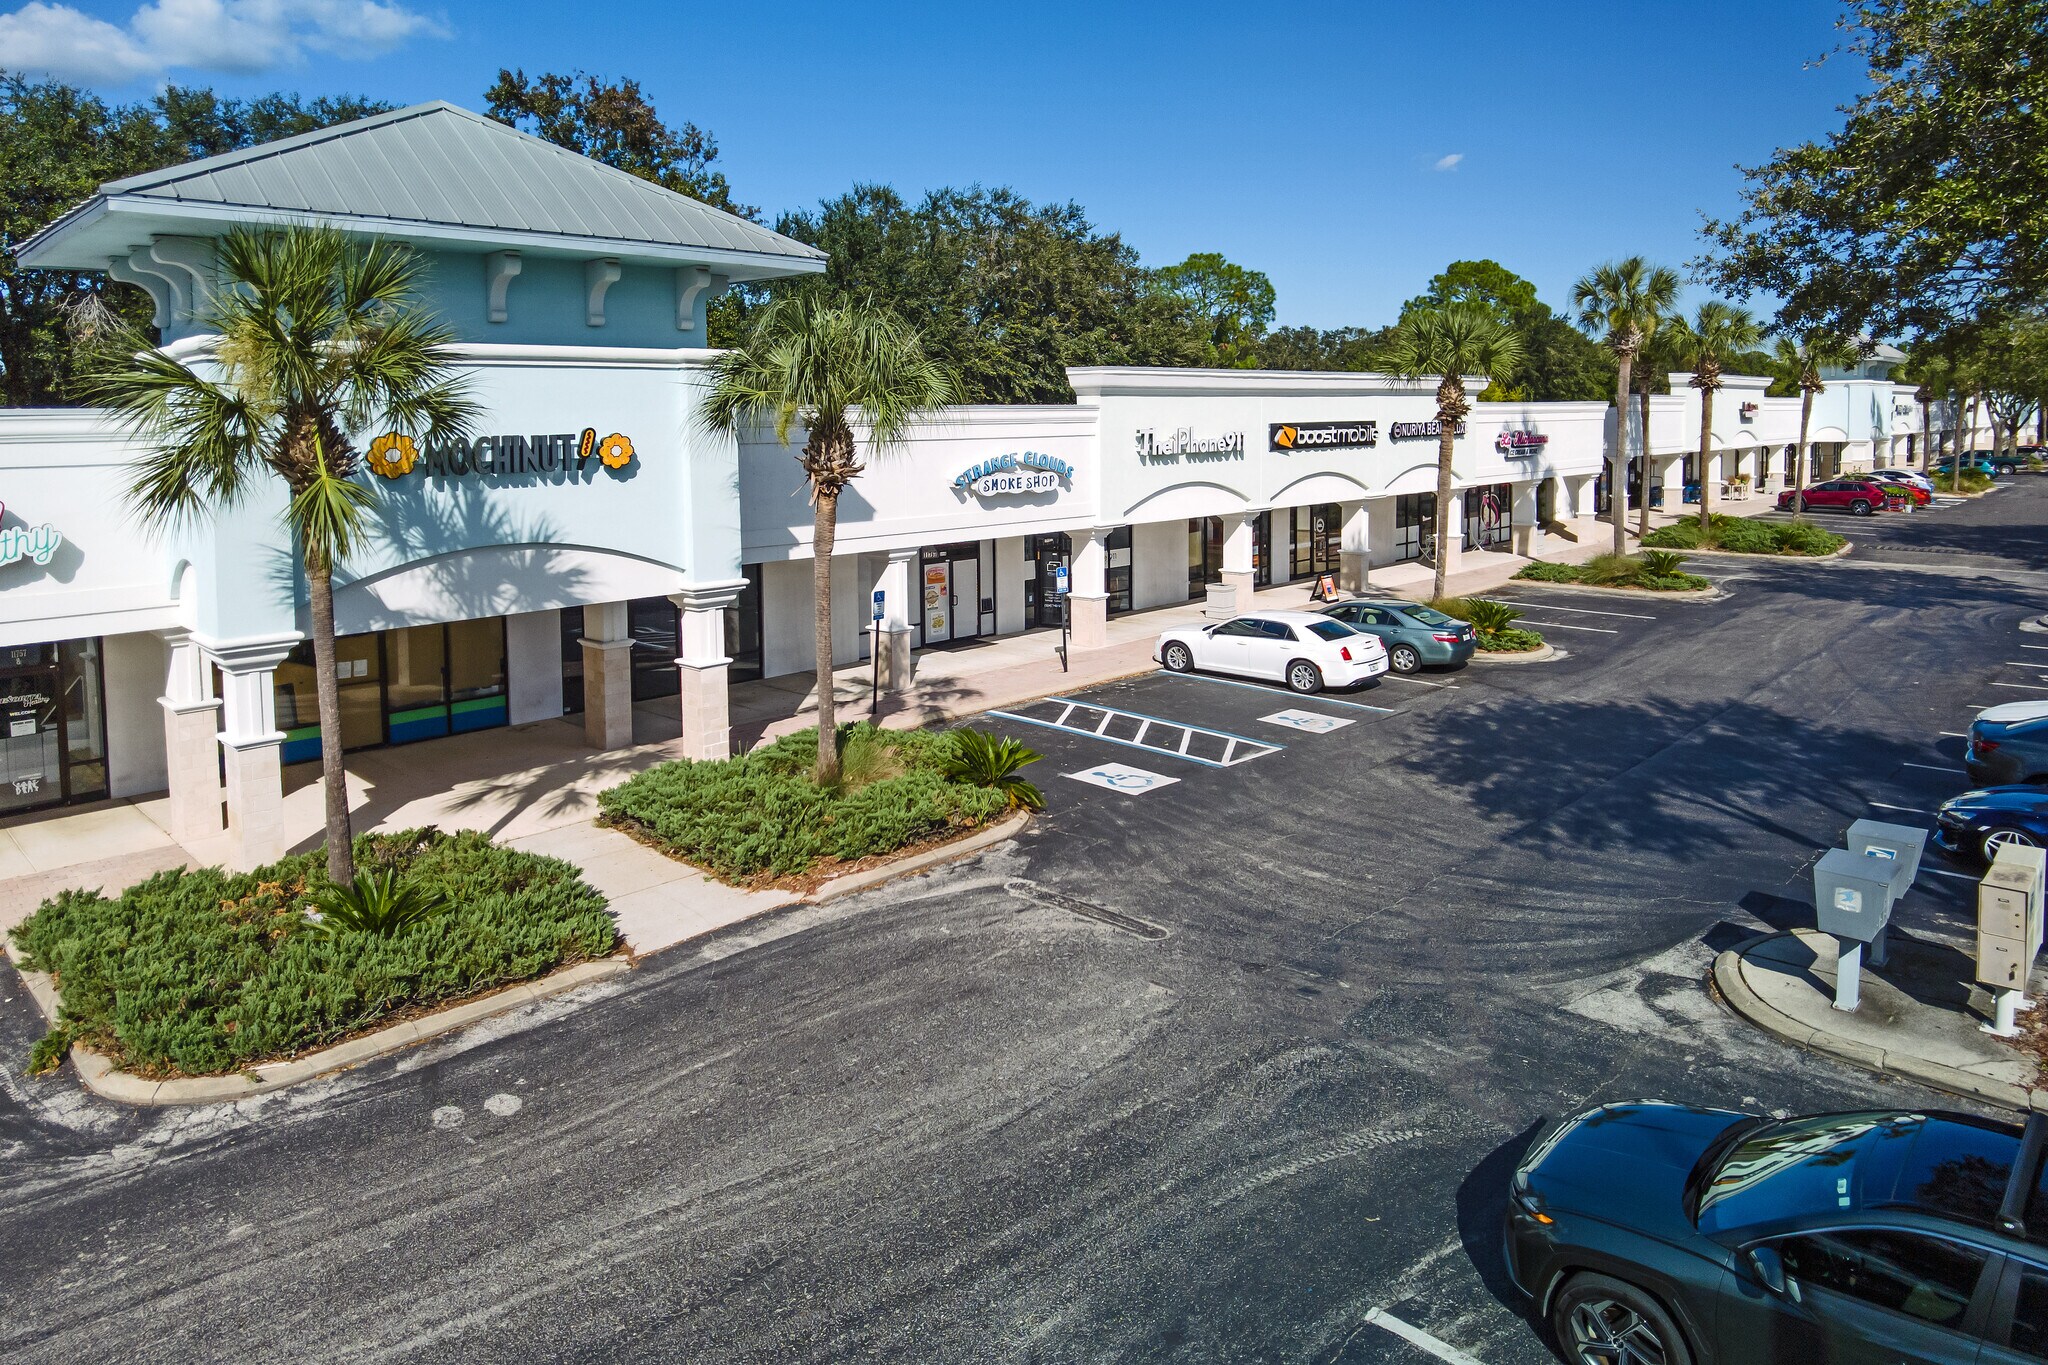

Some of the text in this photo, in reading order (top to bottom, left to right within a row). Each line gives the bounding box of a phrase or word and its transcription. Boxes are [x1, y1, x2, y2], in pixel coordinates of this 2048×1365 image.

[955, 451, 1074, 489] STRANGE CLOUDS
[983, 475, 1055, 492] SMOKE SHOP
